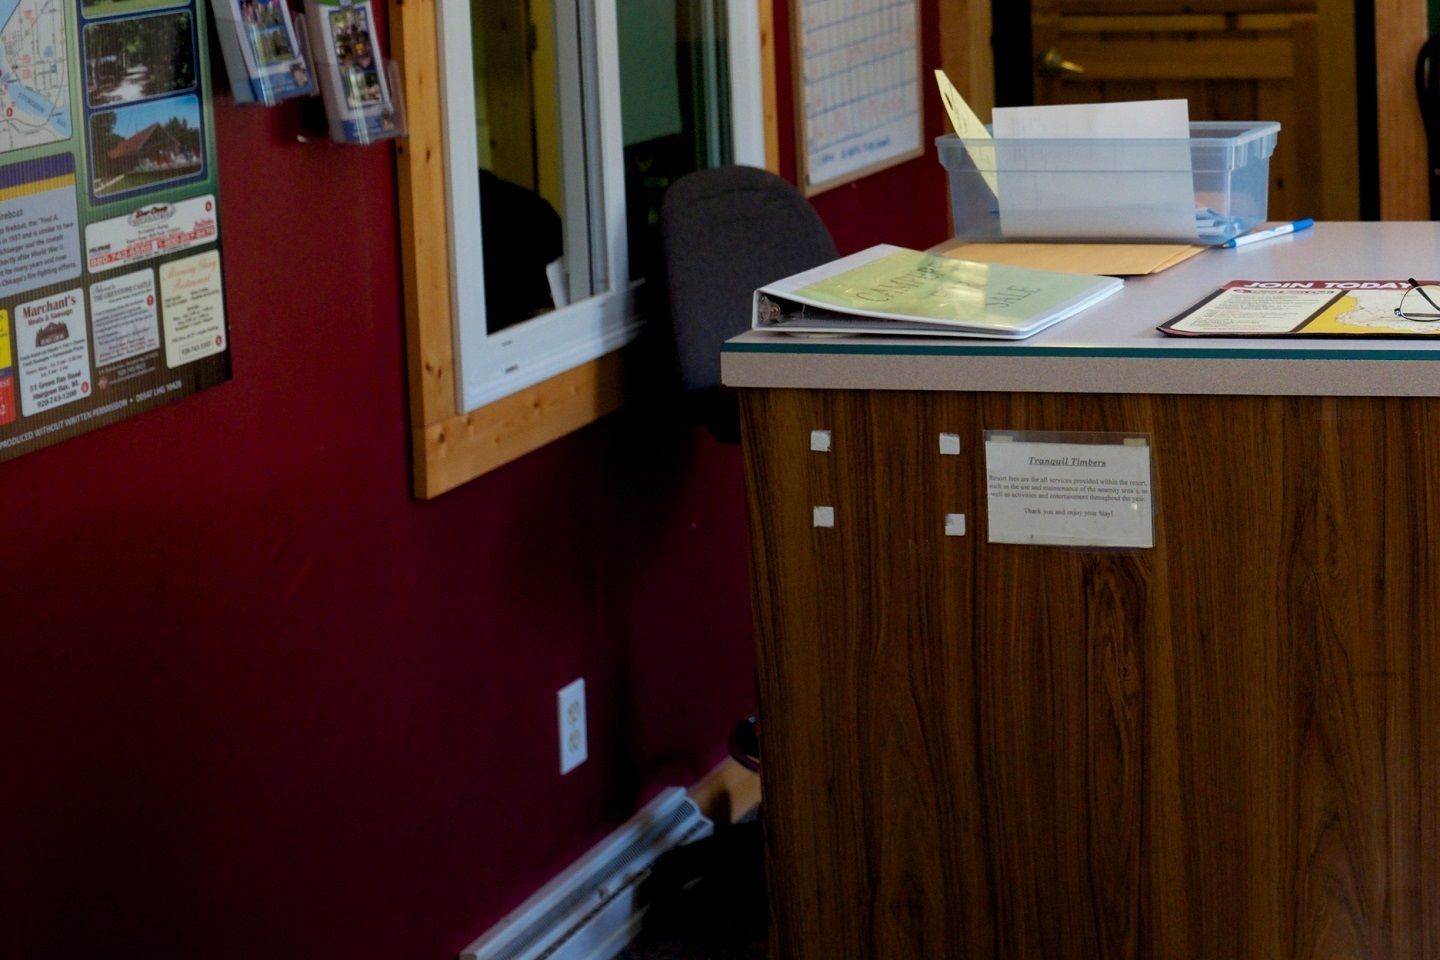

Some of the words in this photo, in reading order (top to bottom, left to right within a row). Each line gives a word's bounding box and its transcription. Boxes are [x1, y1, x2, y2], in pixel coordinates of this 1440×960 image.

[22, 295, 77, 320] Marchant's
[38, 378, 56, 391] Green
[56, 375, 67, 386] Bay
[67, 370, 82, 381] Road
[33, 419, 65, 438] WITHOUT
[65, 410, 92, 427] WRITTEN
[92, 399, 129, 419] PERMISSION
[1028, 456, 1068, 467] Tranquil
[1070, 459, 1107, 468] Timbers
[1073, 478, 1099, 486] provided
[1024, 507, 1042, 515] Thank
[1066, 510, 1082, 518] enjoy
[1083, 510, 1098, 518] your
